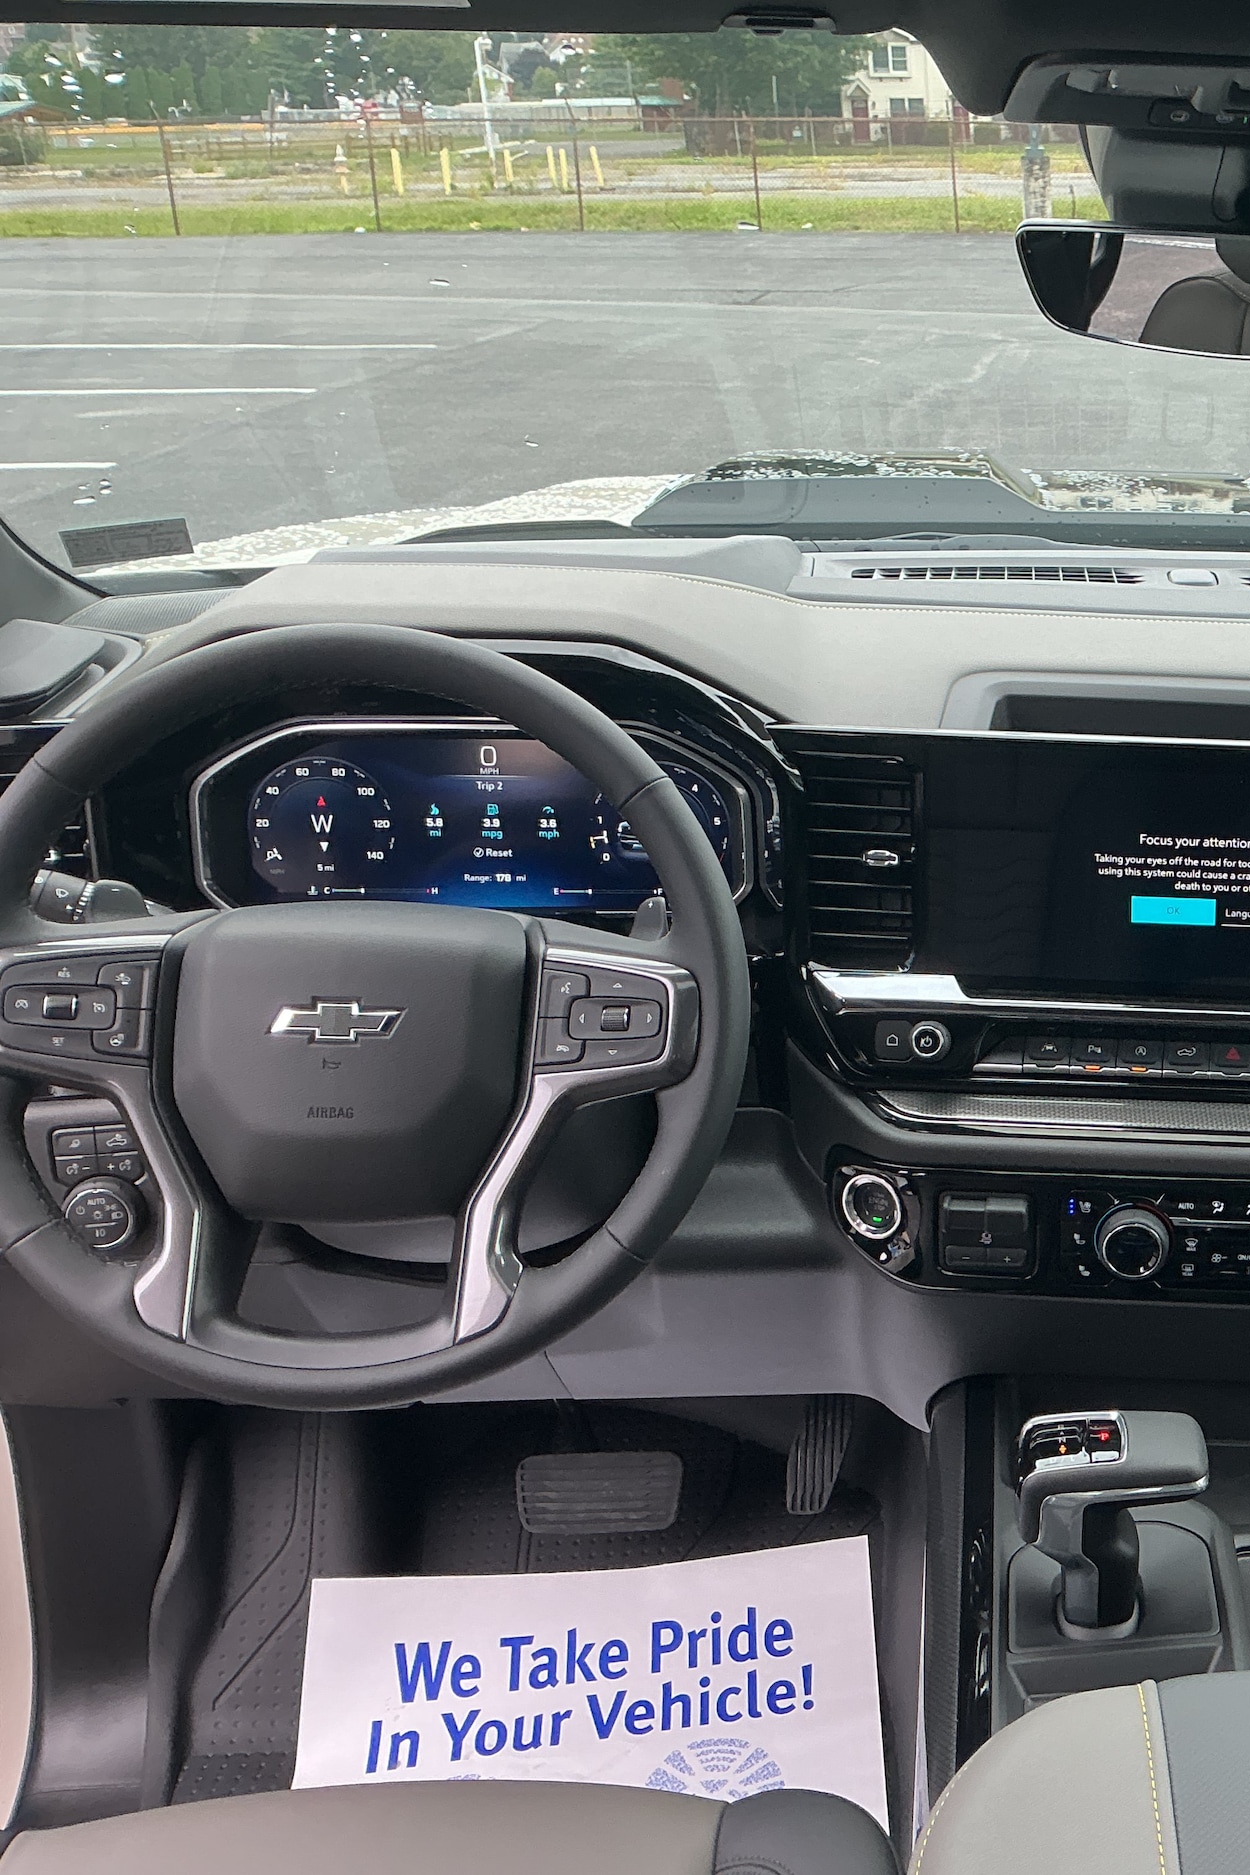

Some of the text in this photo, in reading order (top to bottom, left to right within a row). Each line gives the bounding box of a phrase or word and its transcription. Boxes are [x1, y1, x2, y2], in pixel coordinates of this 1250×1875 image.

[480, 746, 497, 766] 0
[296, 768, 310, 776] 60
[332, 768, 346, 776] 80
[266, 786, 280, 795] 40
[476, 780, 503, 792] Trip 2
[692, 784, 698, 793] 4
[357, 787, 375, 796] 100
[256, 818, 270, 828] 20
[310, 814, 334, 834] W
[373, 820, 390, 828] 120
[714, 816, 721, 826] 5
[429, 829, 442, 837] mi
[481, 830, 503, 840] mpg
[538, 830, 560, 840] mph
[1139, 834, 1174, 846] Focus
[1175, 837, 1200, 849] your
[366, 852, 384, 860] 140
[485, 848, 513, 858] Reset
[1094, 853, 1124, 865] Taking
[1125, 856, 1146, 866] your
[1147, 858, 1168, 867] eyes
[1169, 856, 1184, 866] off
[1184, 856, 1200, 866] the
[1201, 857, 1222, 868] road
[1223, 858, 1236, 868] for
[1098, 866, 1124, 878] using
[1124, 867, 1142, 876] this
[1143, 869, 1174, 879] system
[1176, 870, 1202, 879] could
[1202, 871, 1228, 880] cause
[464, 874, 526, 884] Range: 178 mi
[431, 887, 438, 895] H
[1174, 881, 1200, 891] death
[1202, 883, 1212, 892] to
[1213, 884, 1230, 894] you
[1166, 906, 1180, 915] OK
[306, 1106, 354, 1119] AIRBAG
[87, 1198, 106, 1206] AUTO
[394, 1606, 794, 1704] We Take Pride
[365, 1664, 816, 1774] In Your Vehicle!
